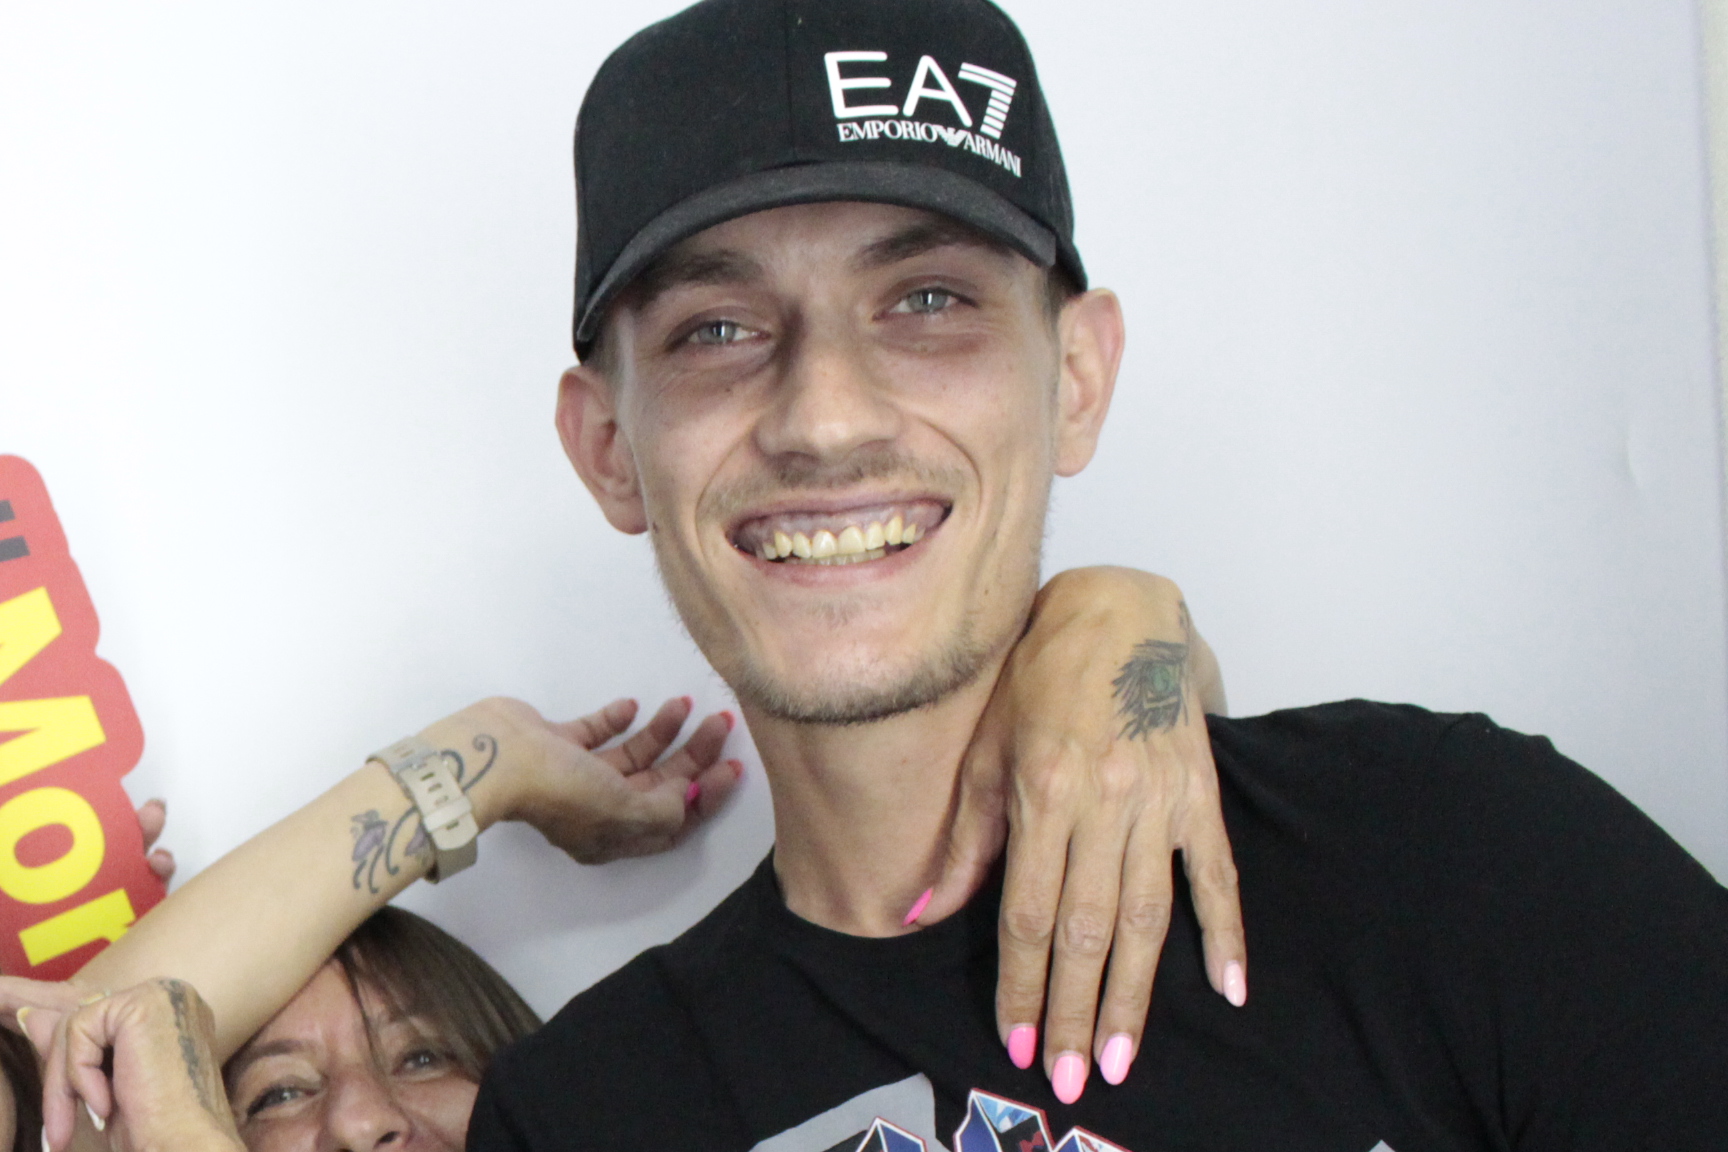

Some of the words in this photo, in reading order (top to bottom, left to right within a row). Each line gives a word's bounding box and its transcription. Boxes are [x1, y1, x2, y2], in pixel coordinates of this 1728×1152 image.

[824, 51, 1017, 139] EA7
[836, 119, 938, 143] EMPORIO
[962, 131, 1021, 178] ARMANI
